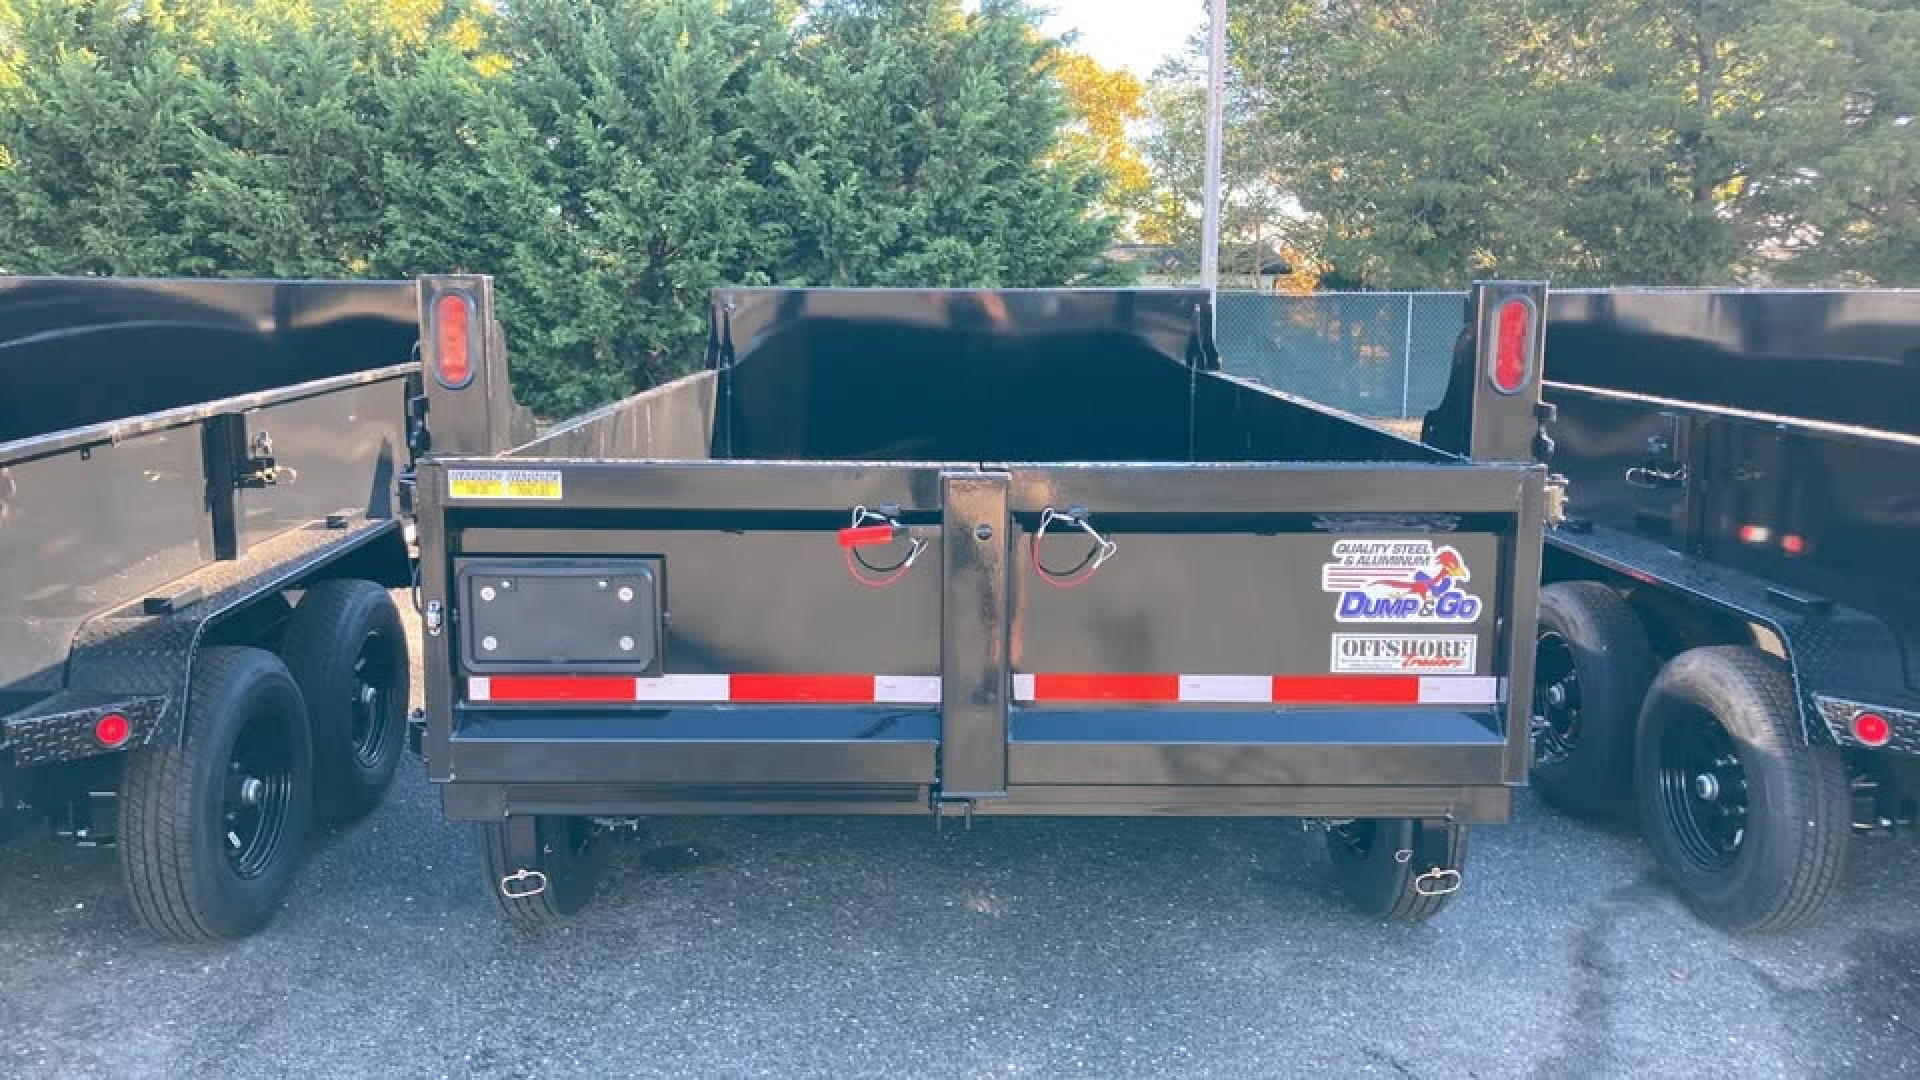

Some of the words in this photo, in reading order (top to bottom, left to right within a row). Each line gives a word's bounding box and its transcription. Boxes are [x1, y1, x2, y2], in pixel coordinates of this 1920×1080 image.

[1337, 544, 1391, 554] QUALITY
[1393, 544, 1430, 554] STEEL
[1344, 555, 1354, 566] &
[1357, 555, 1431, 566] ALUMINUM
[1342, 639, 1468, 657] OFFSHORE
